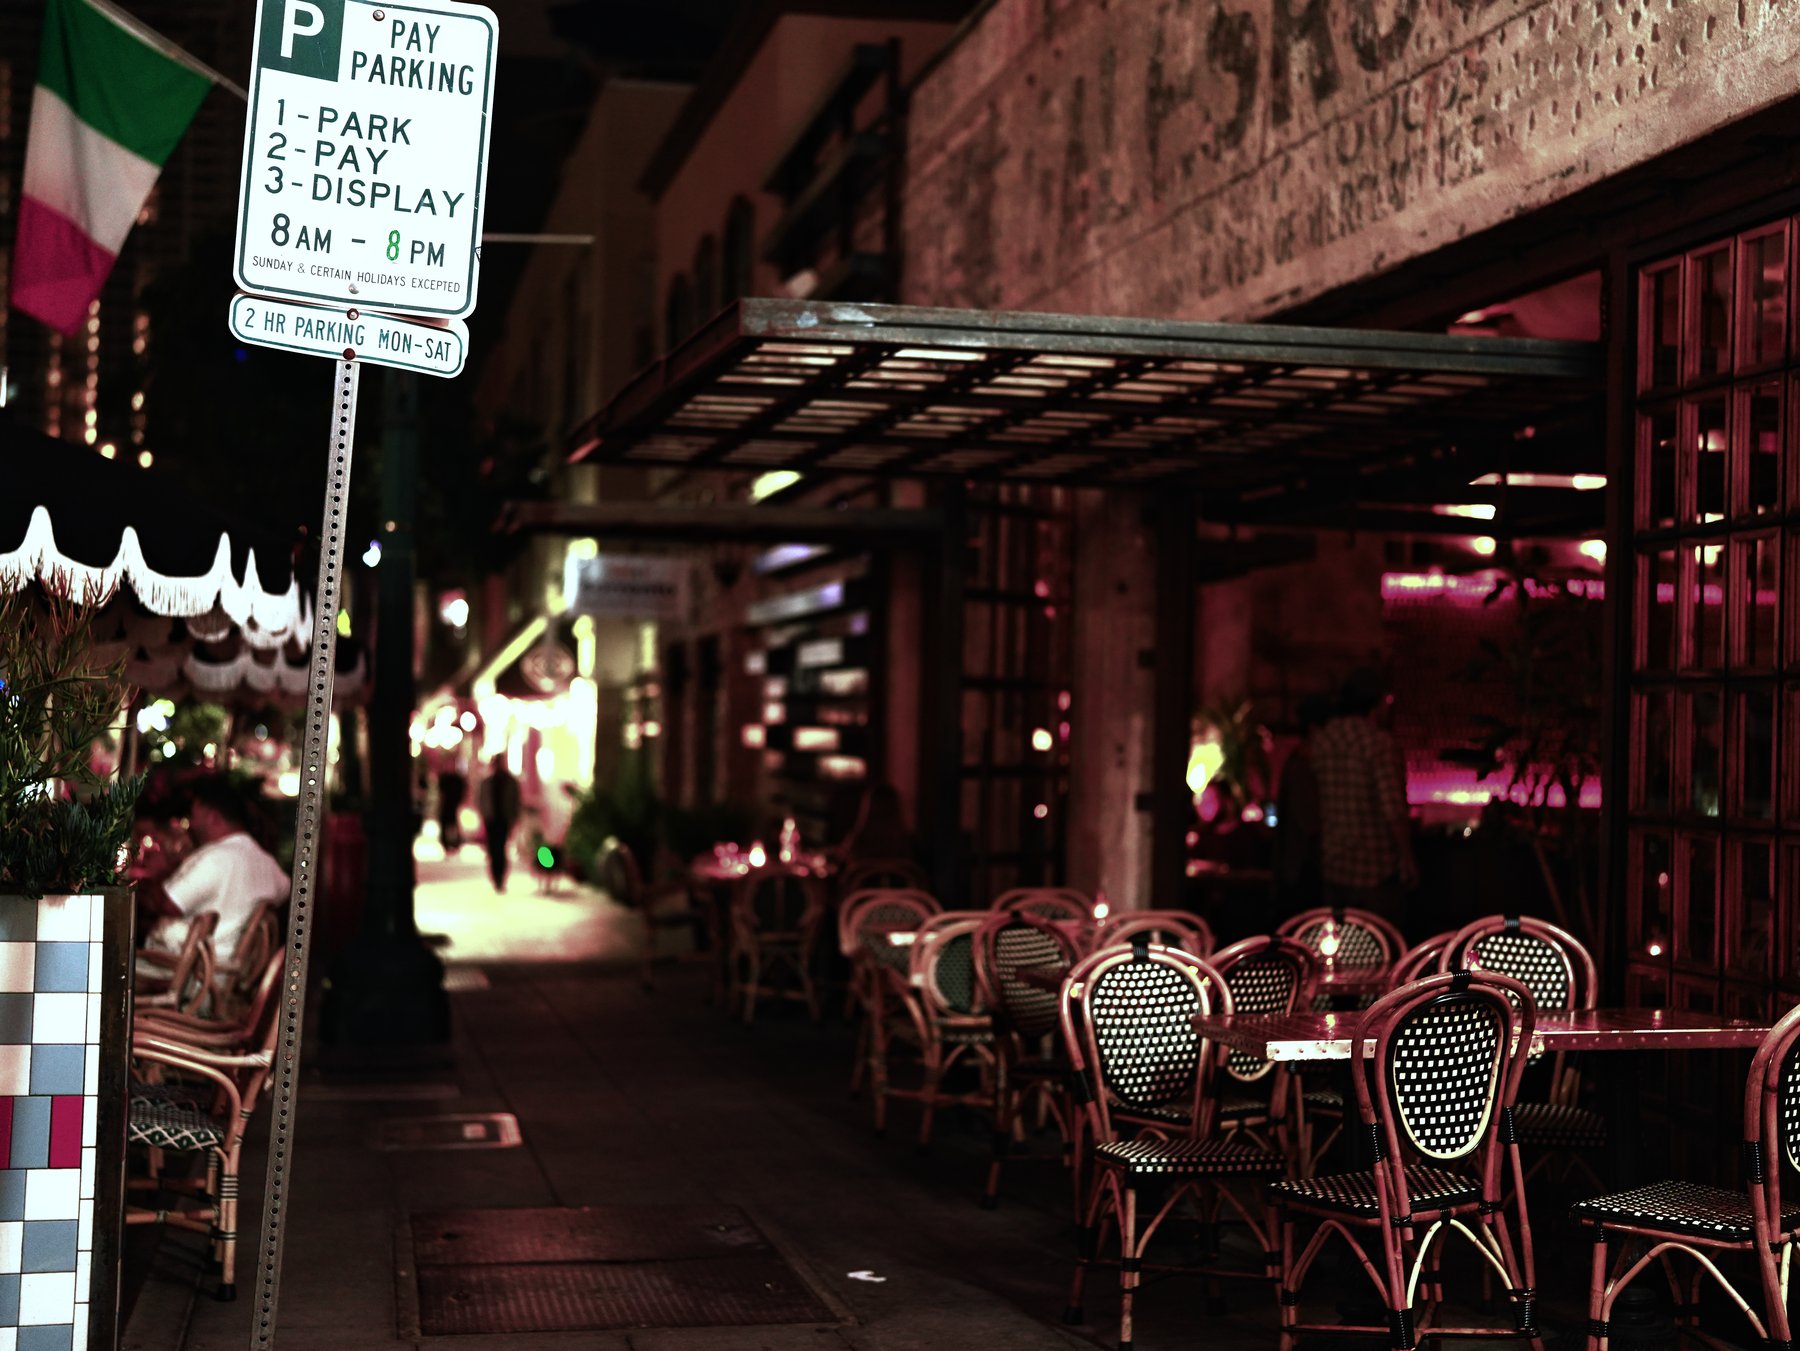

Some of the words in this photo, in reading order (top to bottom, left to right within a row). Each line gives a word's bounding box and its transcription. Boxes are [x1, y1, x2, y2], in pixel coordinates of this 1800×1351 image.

[280, 0, 325, 58] P
[391, 19, 440, 53] PAY
[351, 51, 474, 95] PARKING
[252, 255, 293, 272] SUNDAY
[297, 262, 305, 274] &
[310, 265, 351, 281] CERTAIN
[357, 271, 406, 287] HOLIDAYS
[411, 277, 460, 293] EXCEPTED
[244, 308, 255, 328] 2
[264, 311, 286, 335] HR
[295, 317, 365, 346] PARKING
[379, 328, 452, 362] MON-SAT
